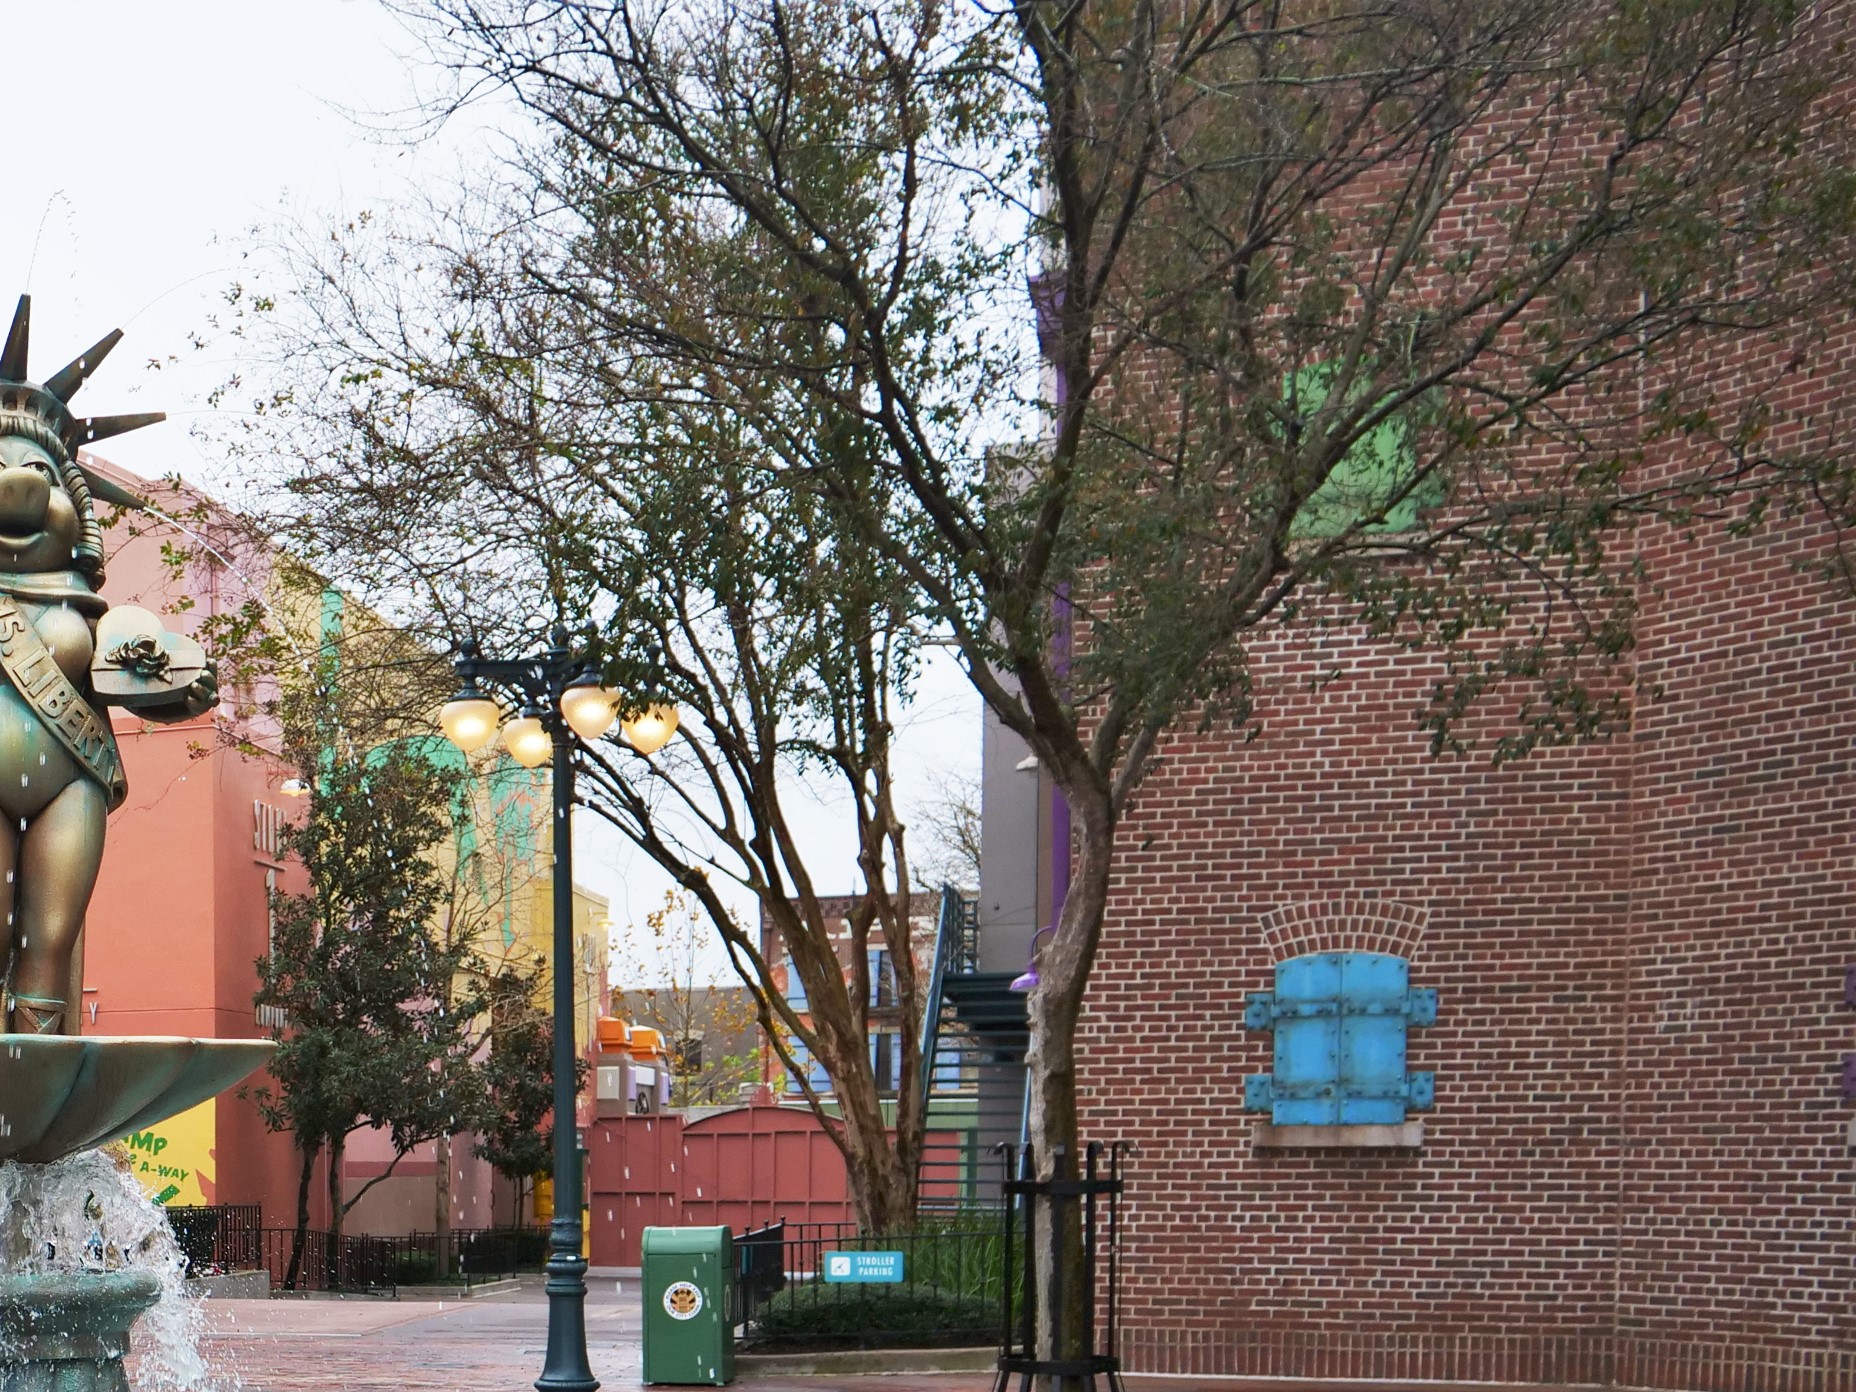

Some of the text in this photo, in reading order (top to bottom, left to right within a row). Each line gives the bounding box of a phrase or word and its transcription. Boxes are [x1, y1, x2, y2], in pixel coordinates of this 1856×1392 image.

[13, 648, 115, 784] LIBERT
[139, 1161, 190, 1181] A-WAY
[857, 1256, 895, 1266] STROLLER
[859, 1267, 894, 1276] PARKING
